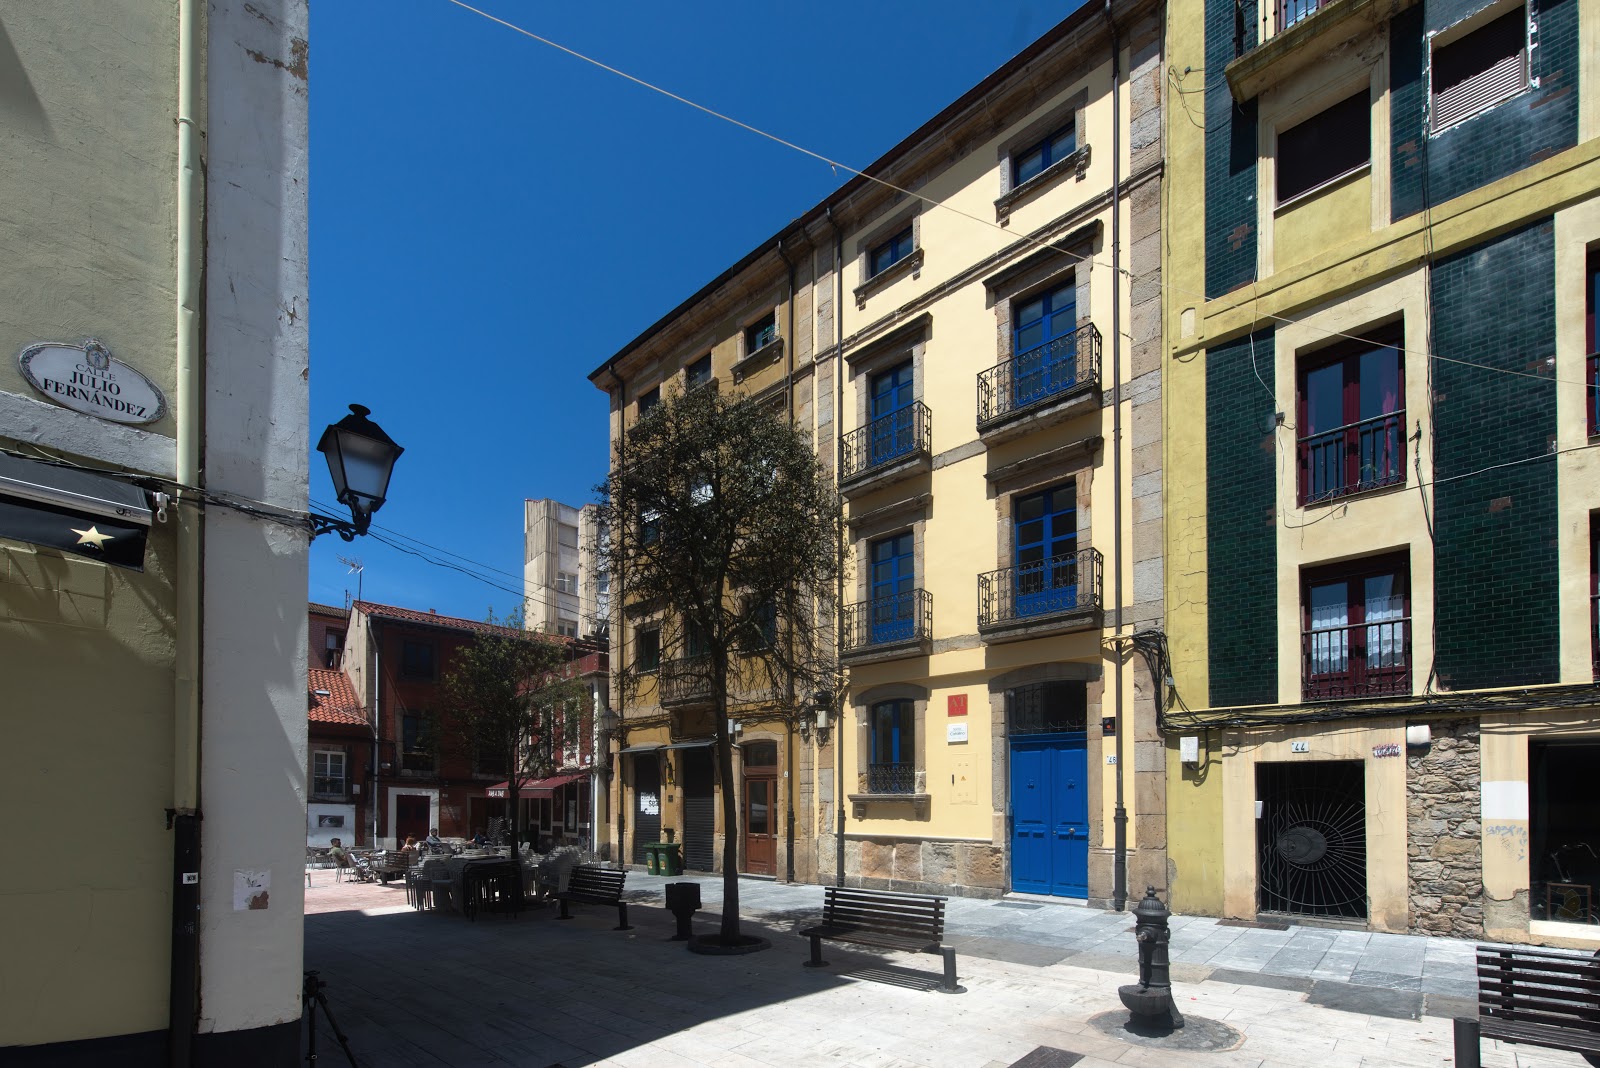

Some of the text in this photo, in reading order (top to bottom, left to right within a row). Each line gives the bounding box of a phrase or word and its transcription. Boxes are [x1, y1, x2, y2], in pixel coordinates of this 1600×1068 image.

[69, 370, 121, 395] JULIO
[75, 363, 116, 381] CALLE
[43, 377, 147, 418] FERNÁNDEZ
[950, 696, 967, 708] AT
